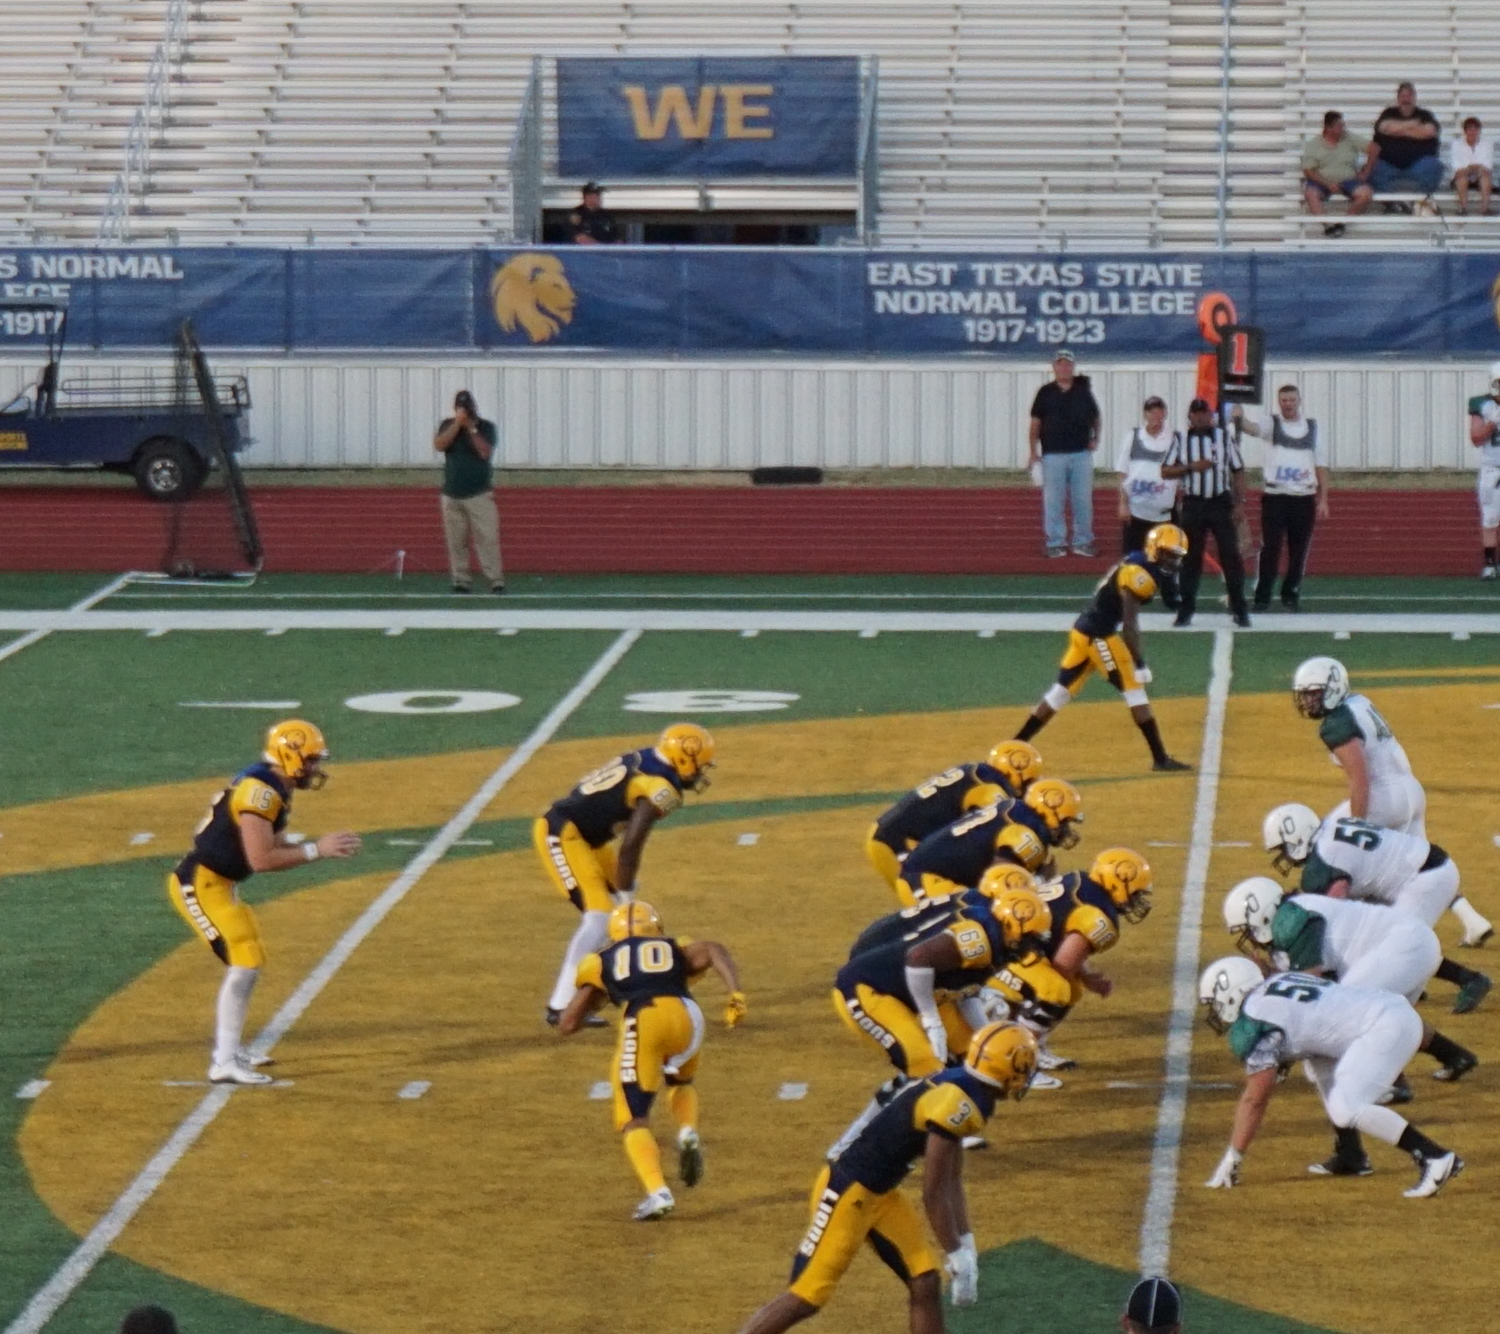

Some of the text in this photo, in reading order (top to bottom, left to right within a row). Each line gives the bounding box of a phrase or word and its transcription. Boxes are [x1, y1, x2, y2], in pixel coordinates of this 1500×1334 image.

[622, 83, 776, 141] WE
[31, 255, 184, 281] NORMAL
[867, 262, 1203, 288] EAST TEXAS STATE
[874, 290, 1196, 316] NORMAL COLLEGE
[963, 319, 1106, 344] 1917-1923
[1231, 331, 1249, 376] 1
[545, 833, 580, 894] LIONS
[180, 882, 221, 943] LIONS
[611, 938, 675, 979] 10
[958, 928, 988, 962] 63
[844, 995, 897, 1050] LIONS
[619, 1016, 639, 1084] LIONS
[948, 1101, 974, 1128] 3
[799, 1186, 839, 1259] LIONS
